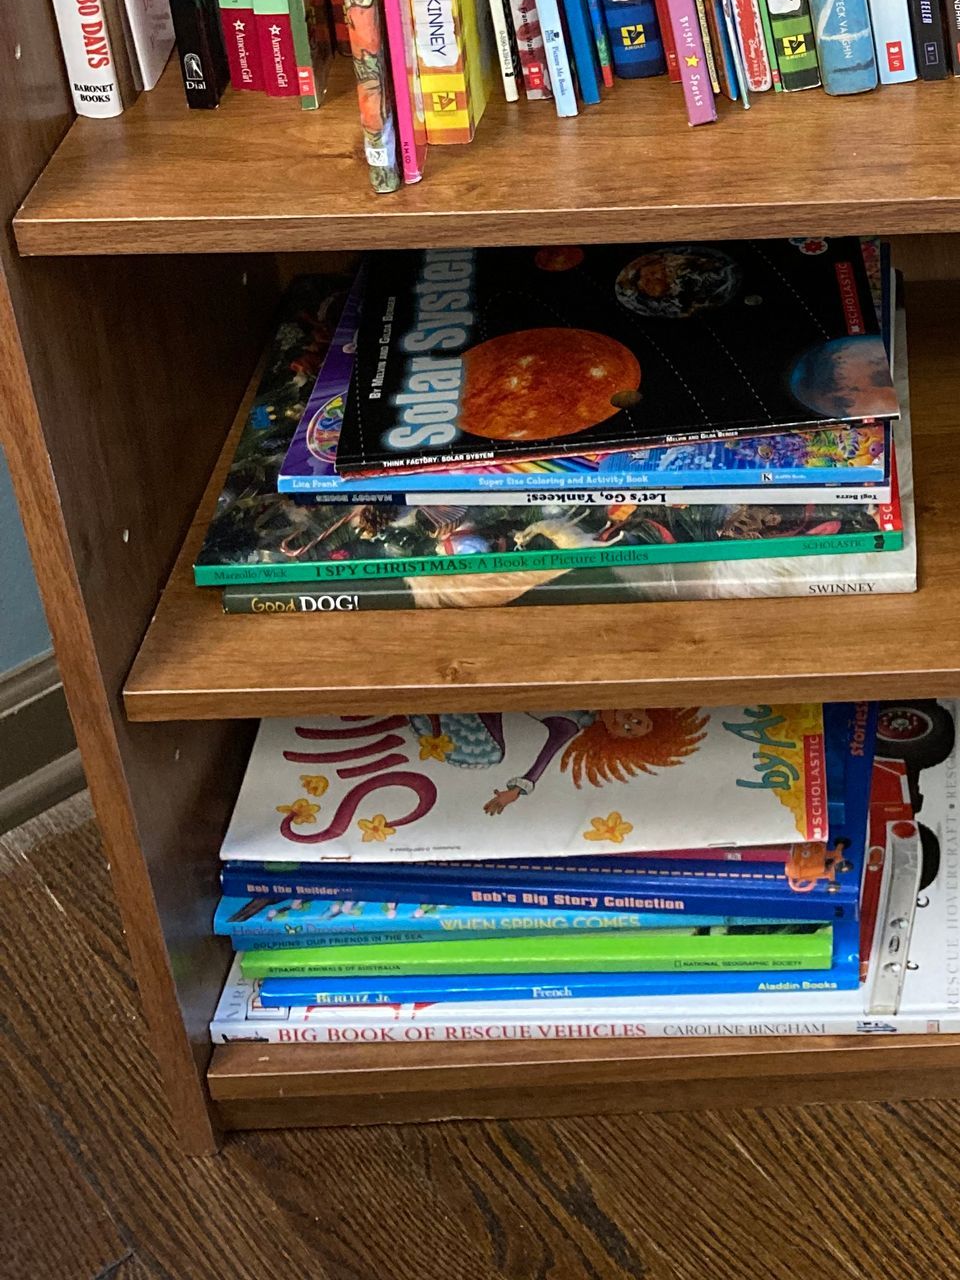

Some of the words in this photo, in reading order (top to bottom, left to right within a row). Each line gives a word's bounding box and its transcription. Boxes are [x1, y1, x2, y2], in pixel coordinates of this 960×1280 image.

[80, 22, 110, 69] DAYS
[680, 16, 696, 48] Bright
[688, 74, 704, 106] Sparks
[74, 83, 114, 92] BARONET
[80, 94, 110, 102] BOOKS
[386, 356, 463, 448] Solar
[526, 491, 596, 505] Yankees!
[599, 491, 623, 505] Go,
[629, 491, 666, 503] Let's
[316, 564, 324, 577] I
[326, 563, 359, 577] SPY
[363, 557, 473, 577] CHRISTMAS:
[809, 582, 876, 594] SWINNEY
[251, 597, 296, 612] Good
[300, 594, 359, 612] DOG!
[811, 735, 821, 824] SCHOLASTIC
[471, 890, 515, 902] Bob's
[523, 893, 548, 906] Big
[554, 895, 597, 908] Story
[604, 896, 684, 910] Collection
[532, 987, 572, 997] French
[758, 981, 799, 990] Aladdin
[803, 981, 837, 990] Books
[278, 1028, 320, 1042] BIG
[327, 1027, 397, 1041] BOOK
[404, 1026, 437, 1039] OF
[445, 1025, 532, 1039] RESCUE
[538, 1024, 645, 1038] VEHICLES
[663, 1025, 745, 1036] CAROLINE
[748, 1024, 826, 1035] BINGHAM
